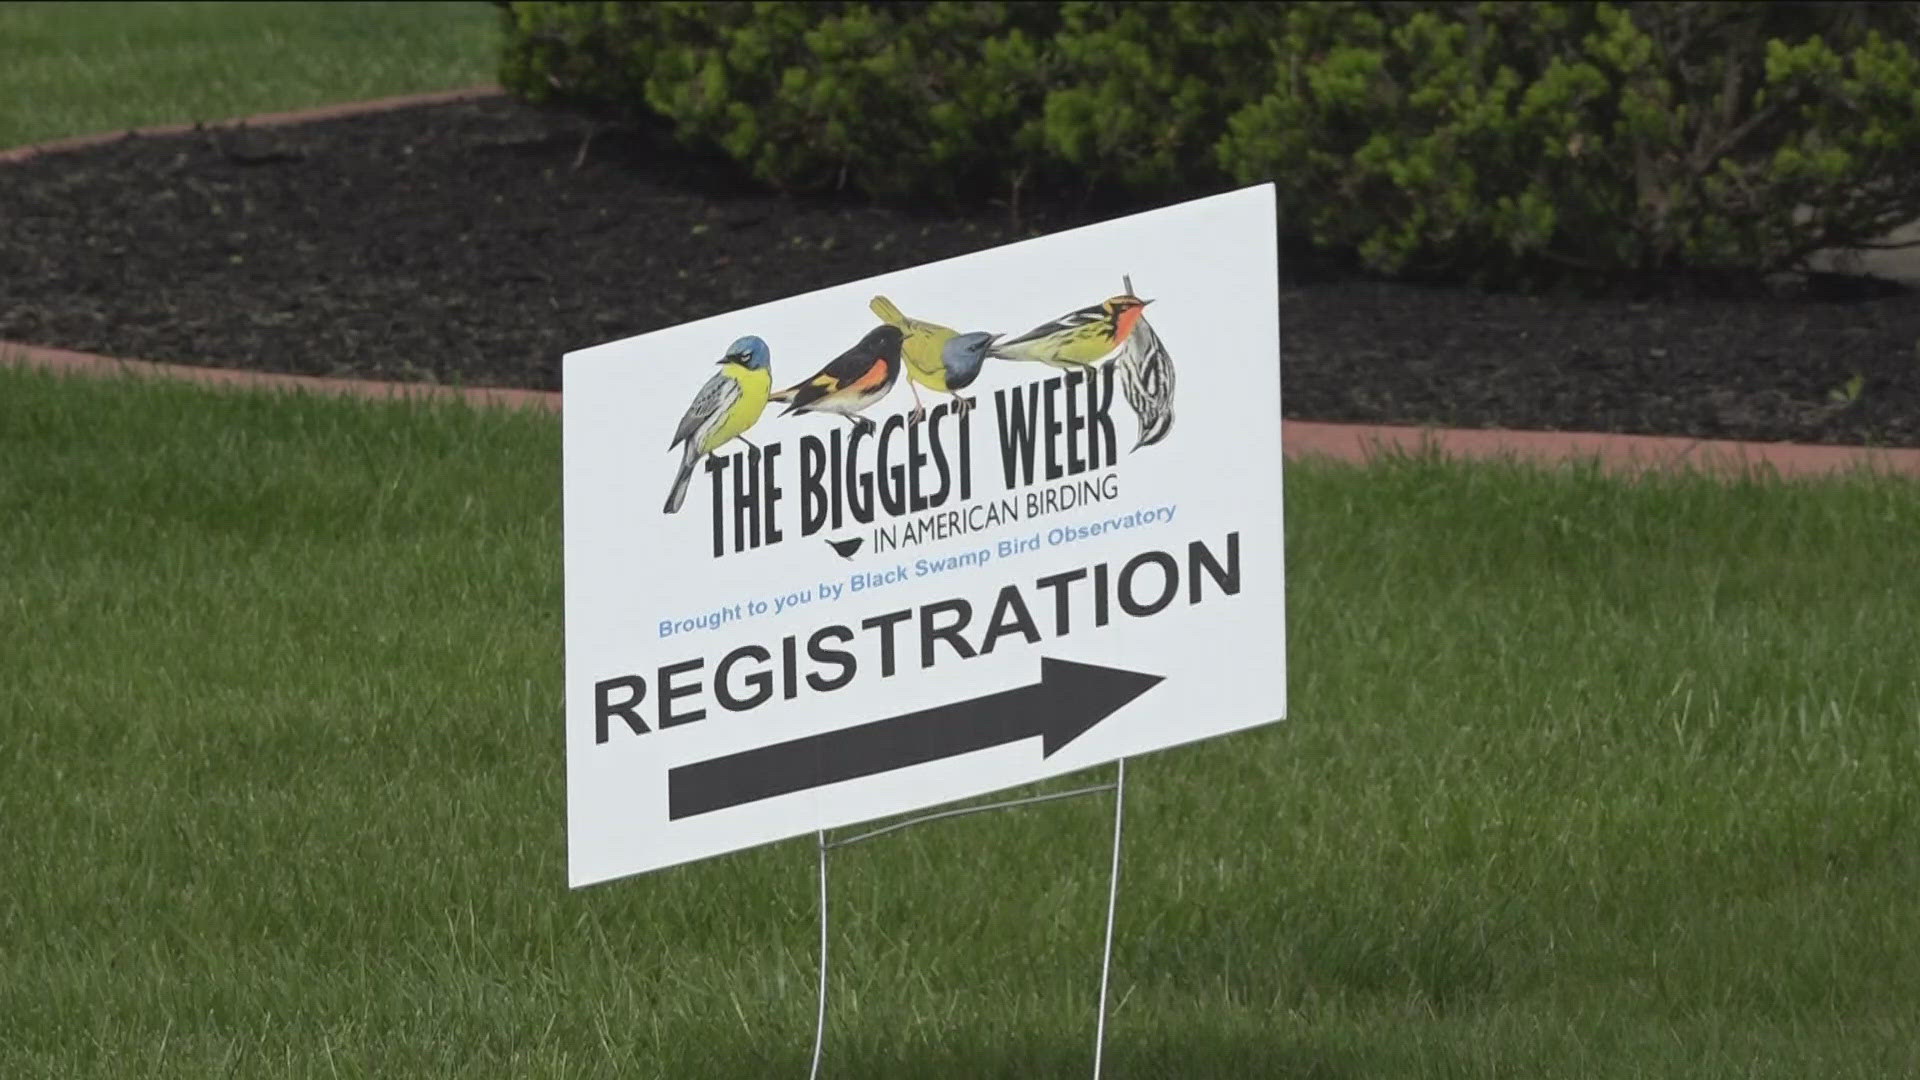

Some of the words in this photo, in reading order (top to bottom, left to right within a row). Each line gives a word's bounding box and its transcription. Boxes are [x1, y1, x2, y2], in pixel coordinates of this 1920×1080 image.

[705, 442, 782, 558] THE
[800, 397, 976, 537] BIGGEST
[995, 364, 1117, 490] WEEK
[874, 527, 896, 553] IN
[902, 496, 1018, 547] AMERICAN
[1027, 474, 1118, 518] BIRDING
[595, 532, 1241, 745] REGISTRATION
[659, 606, 742, 638] Brought
[748, 599, 768, 617] to
[774, 591, 811, 615] you
[818, 581, 844, 605] by
[851, 565, 908, 592] Black
[915, 548, 991, 578] Swamp
[999, 533, 1040, 558] Bird
[1048, 505, 1177, 546] Observatory
